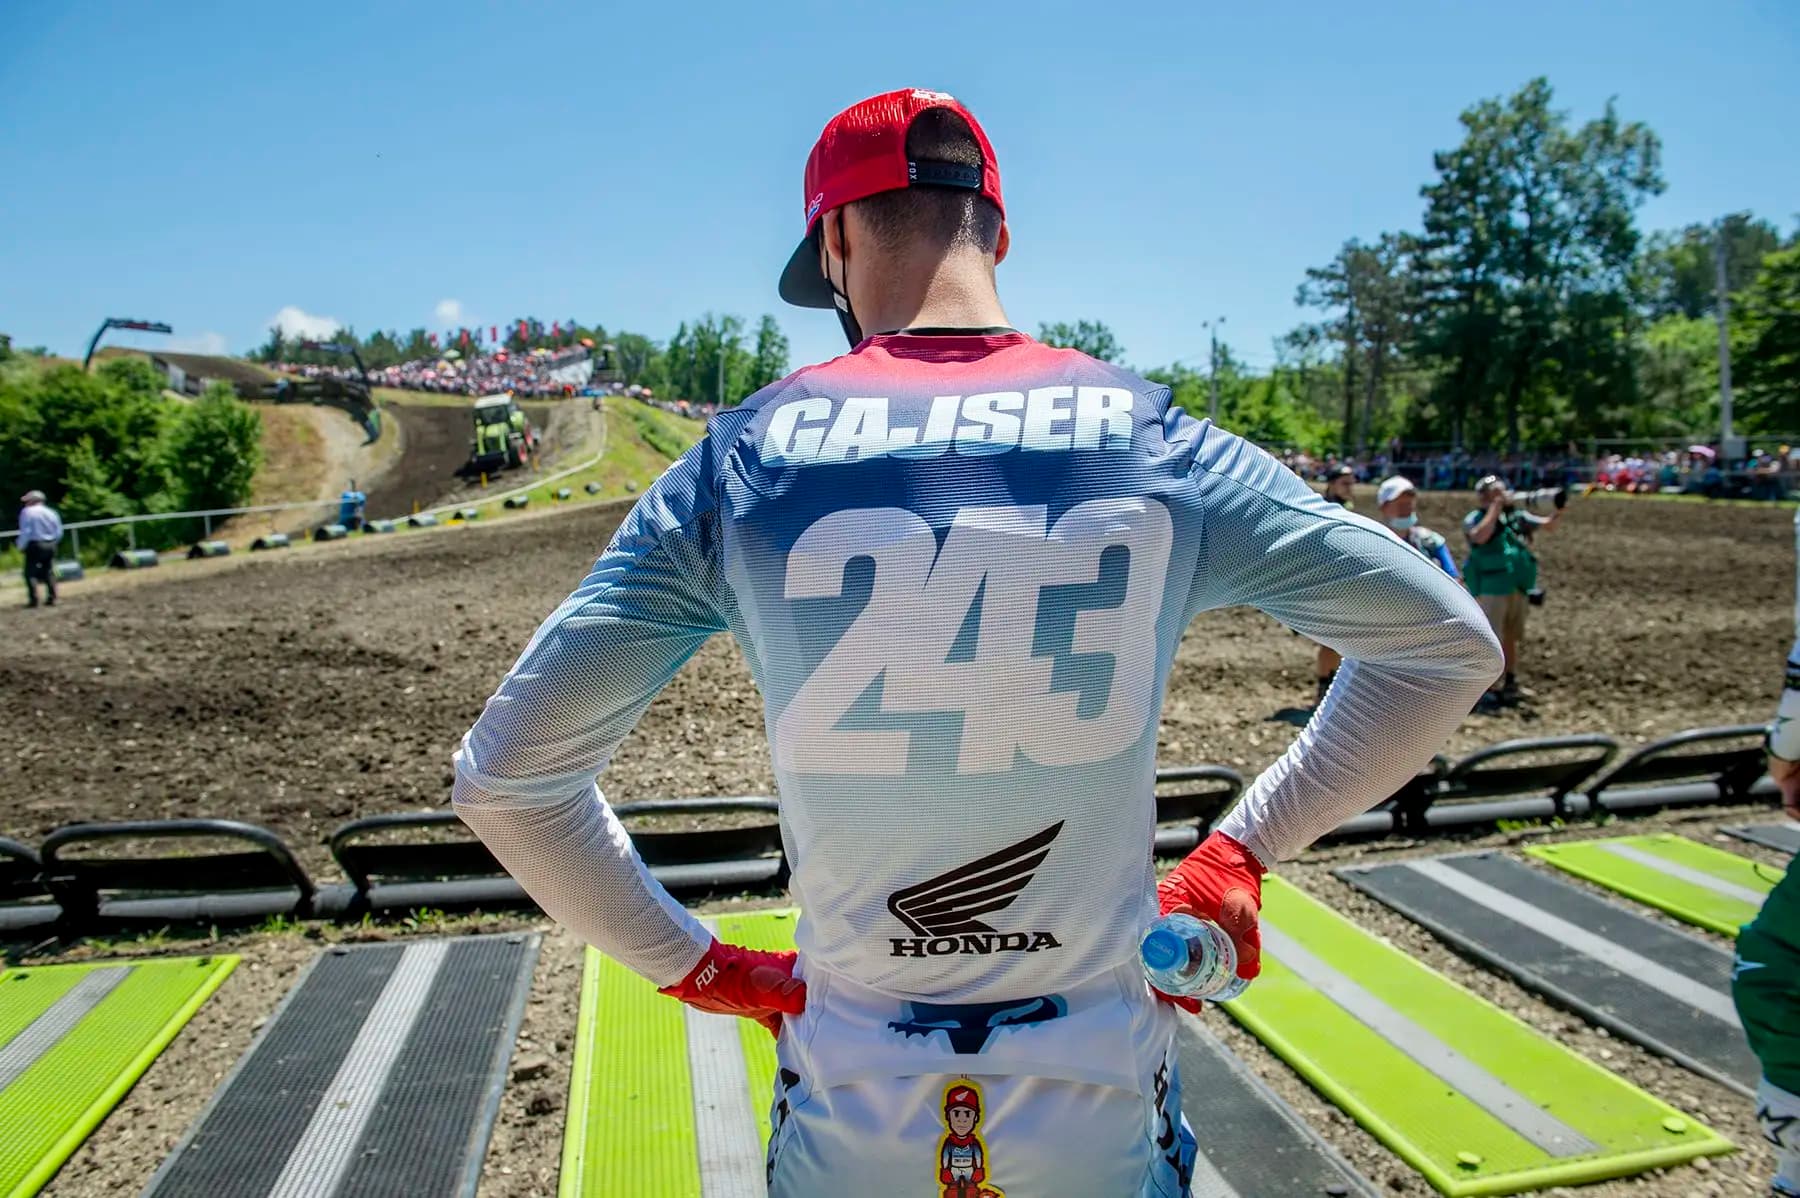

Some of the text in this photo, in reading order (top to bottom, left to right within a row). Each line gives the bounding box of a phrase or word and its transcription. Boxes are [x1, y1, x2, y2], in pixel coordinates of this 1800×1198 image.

[908, 161, 918, 180] FOX
[762, 386, 1133, 468] GAJSER
[776, 496, 1174, 775] 243
[889, 932, 1062, 957] HONDA
[695, 959, 719, 991] FOX
